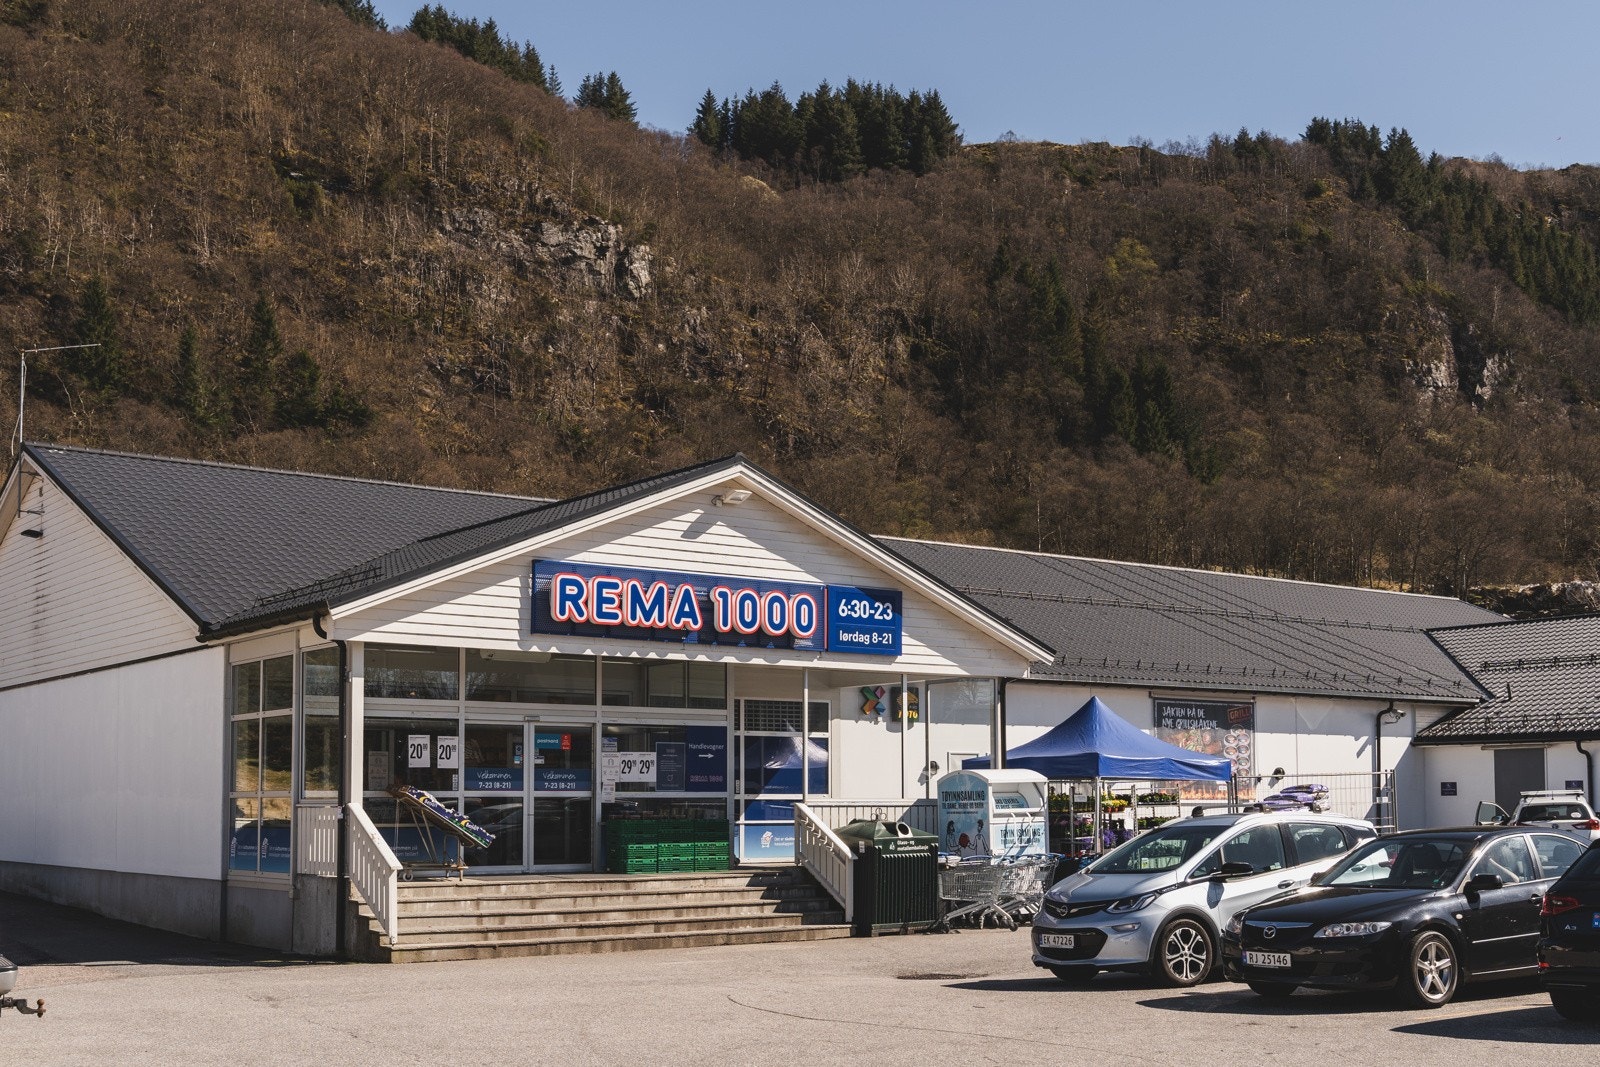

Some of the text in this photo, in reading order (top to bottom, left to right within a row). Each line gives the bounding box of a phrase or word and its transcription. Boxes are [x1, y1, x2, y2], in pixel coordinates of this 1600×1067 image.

[551, 572, 818, 638] REMA 1000
[838, 599, 893, 620] 6:30-23
[839, 630, 892, 645] lørdag 8-21
[1197, 708, 1205, 718] DE
[410, 743, 423, 759] 20
[439, 744, 452, 760] 20
[688, 743, 725, 751] Handlevogner
[621, 759, 632, 774] 29
[639, 759, 650, 774] 29
[477, 770, 512, 779] Velkommen
[543, 771, 576, 780] Velkommen
[1043, 935, 1073, 946] EK 47226
[1249, 953, 1288, 966] RJ 25146
